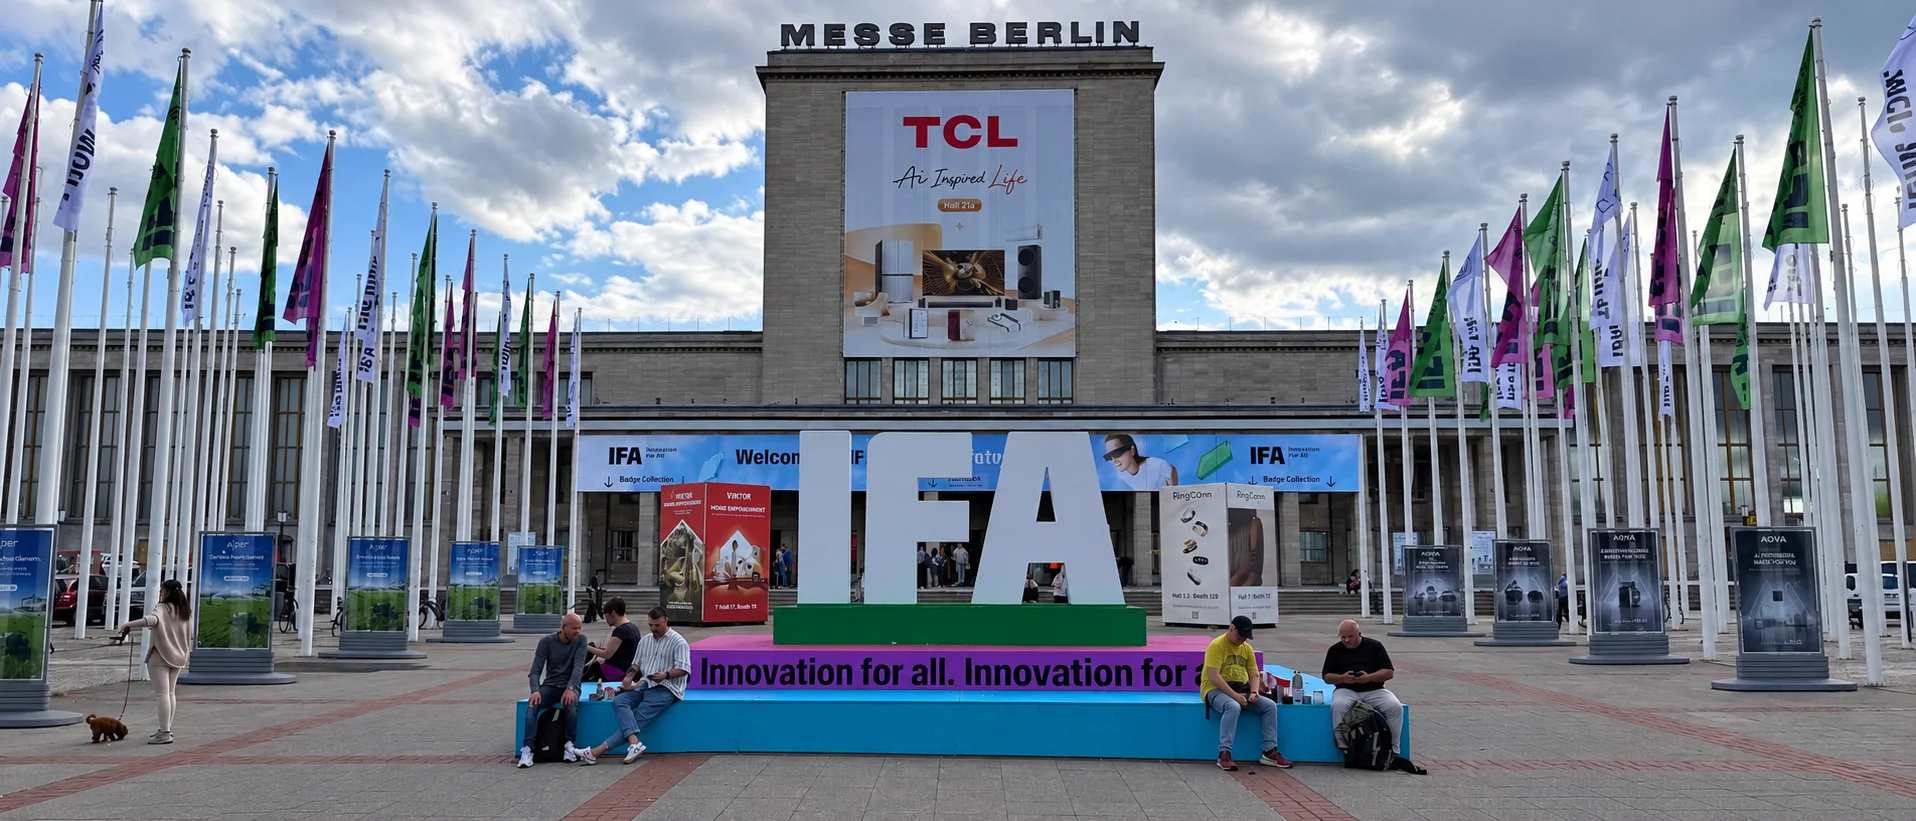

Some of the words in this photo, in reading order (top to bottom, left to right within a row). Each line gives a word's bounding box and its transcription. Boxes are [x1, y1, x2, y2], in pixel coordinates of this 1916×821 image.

[780, 22, 946, 46] MESSE
[969, 20, 1140, 46] BERLIN
[903, 114, 1018, 149] TCL
[893, 165, 929, 189] Ai
[930, 168, 986, 190] Inspired
[988, 164, 1028, 195] Life
[608, 447, 642, 465] IFA
[1250, 446, 1285, 464] IFA
[619, 476, 641, 484] Badge
[1263, 476, 1285, 484] Badge
[797, 431, 1125, 604] IFA
[1760, 535, 1787, 543] AOVA
[701, 656, 854, 687] Innovation
[861, 656, 903, 687] for
[911, 656, 955, 687] all.
[964, 656, 1135, 688] Innovation
[1140, 657, 1188, 688] for
